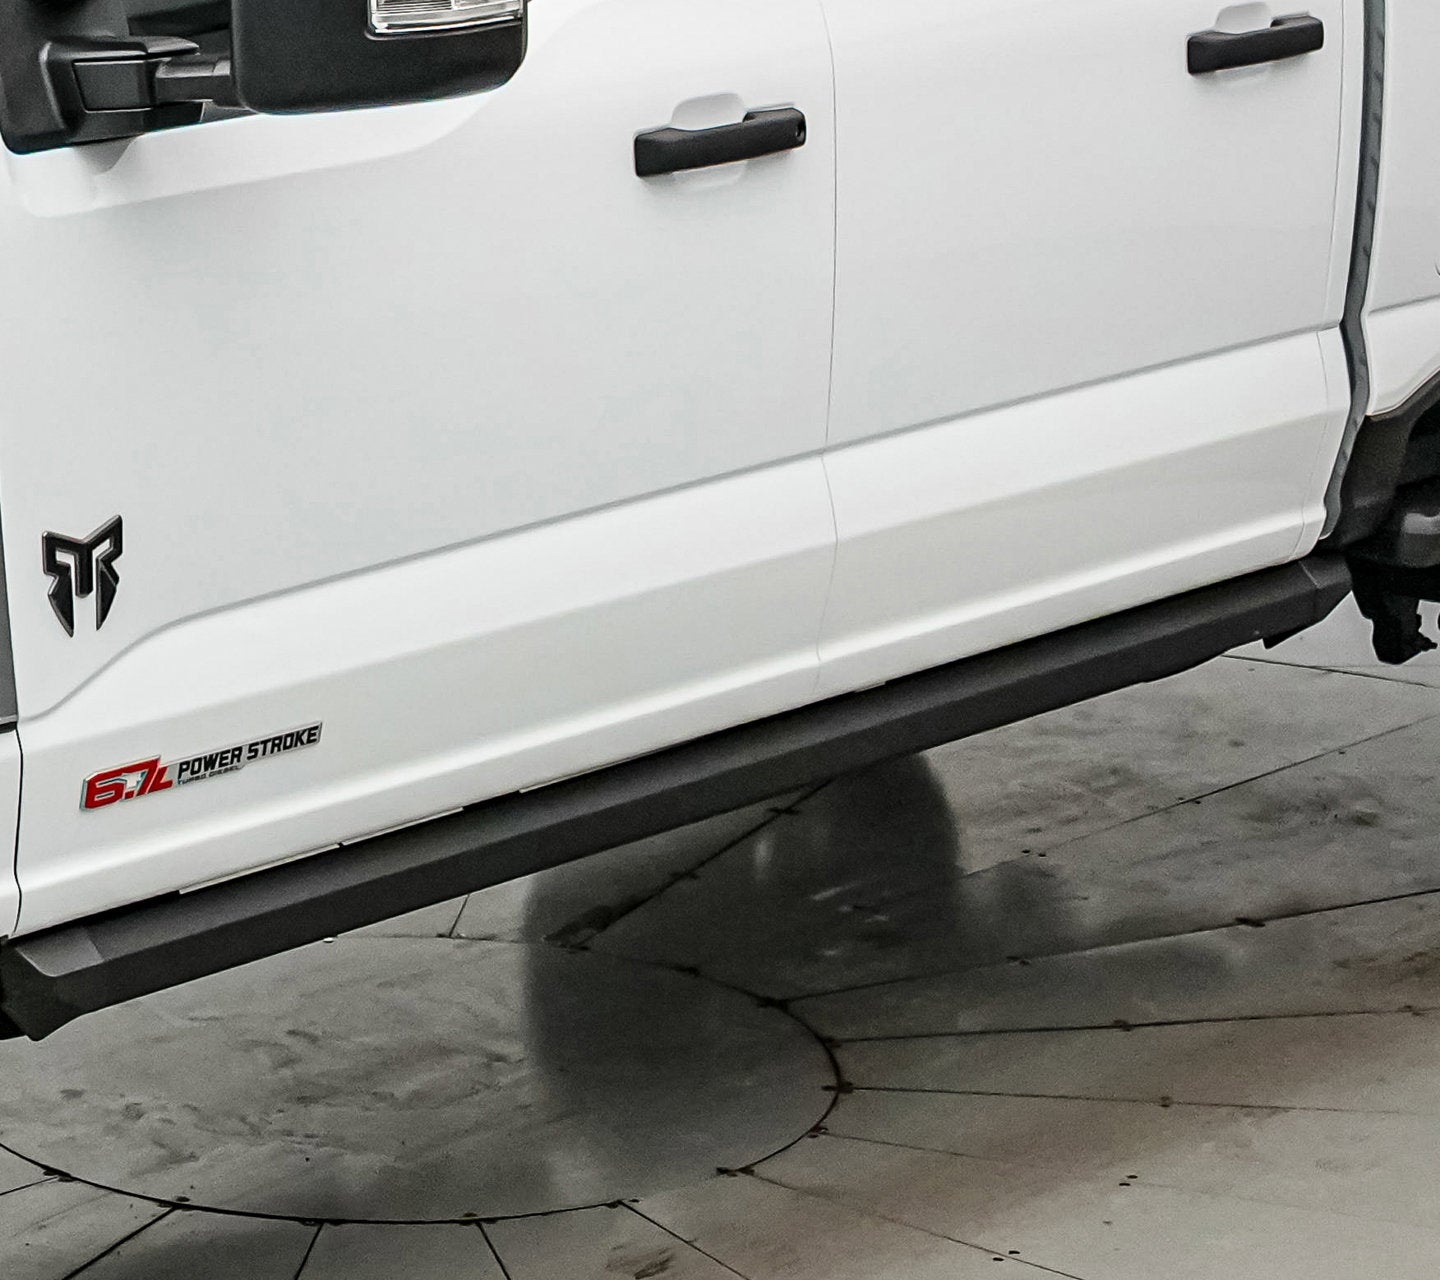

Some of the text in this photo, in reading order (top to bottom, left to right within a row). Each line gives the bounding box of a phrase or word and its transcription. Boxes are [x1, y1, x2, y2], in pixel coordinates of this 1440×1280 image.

[81, 724, 320, 811] 6.7L POWER STROKE
